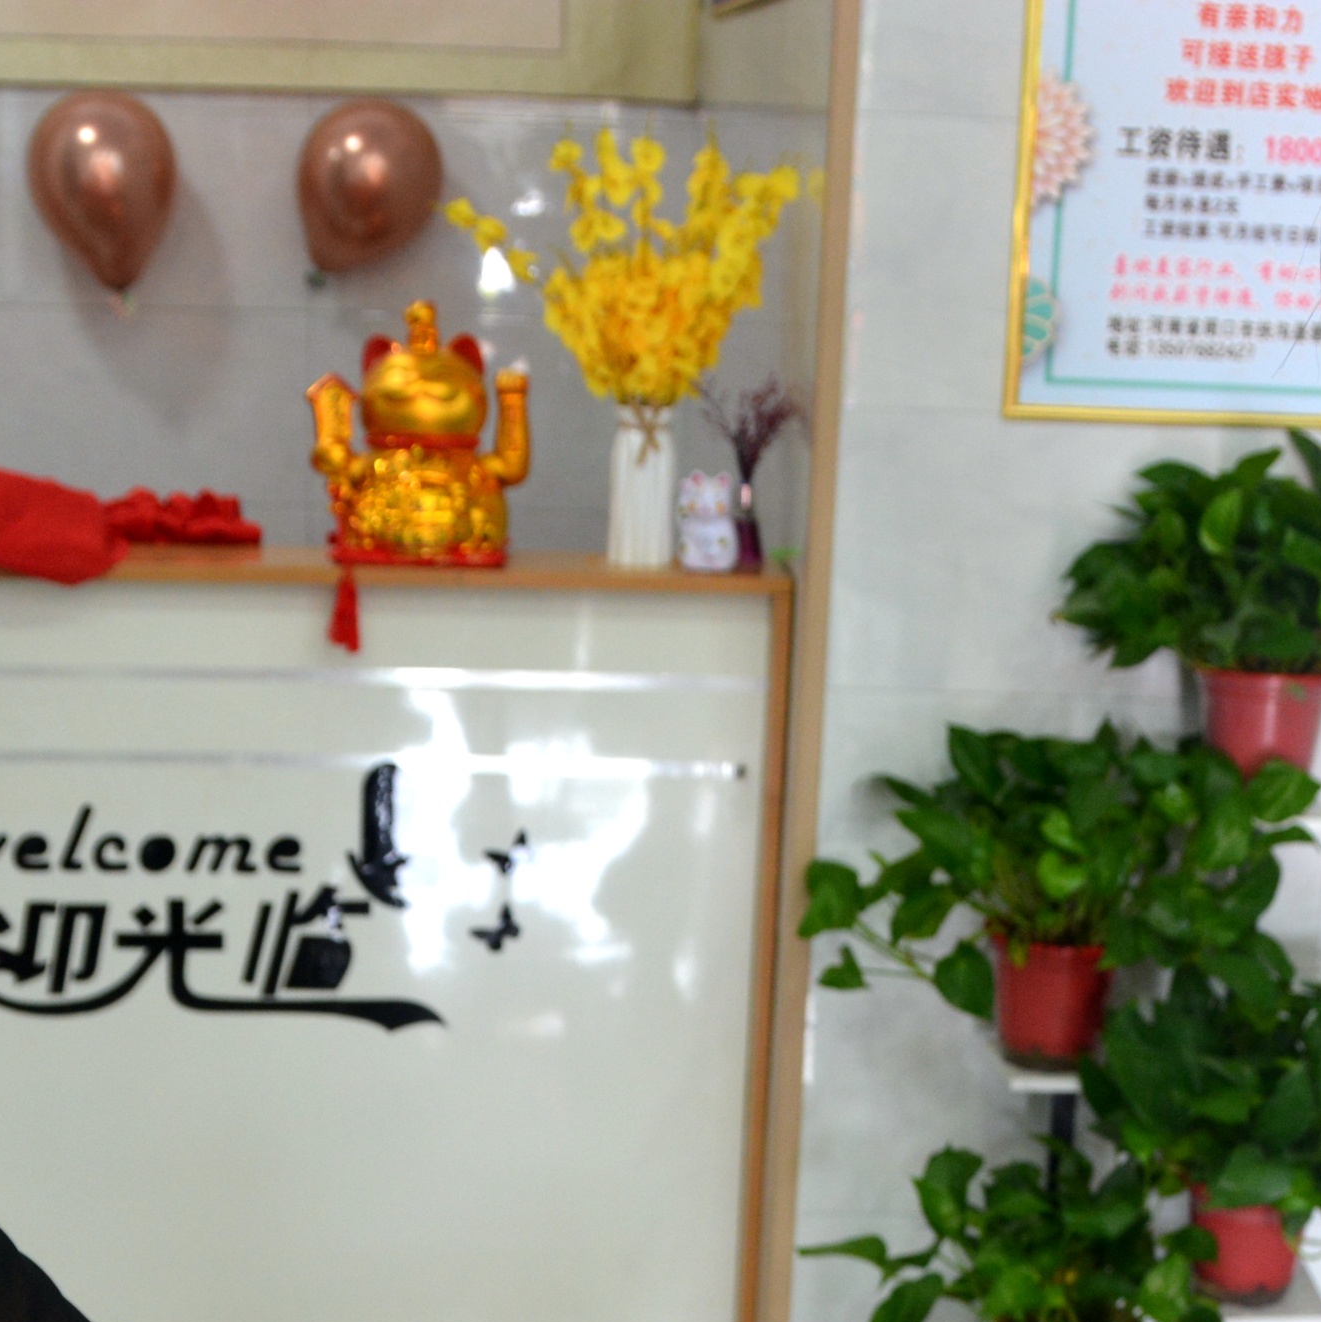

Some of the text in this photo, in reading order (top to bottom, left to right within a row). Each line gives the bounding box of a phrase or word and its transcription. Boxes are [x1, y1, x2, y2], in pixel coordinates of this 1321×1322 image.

[1199, 3, 1303, 34] 有亲和力
[1181, 38, 1314, 74] 可接送孩子
